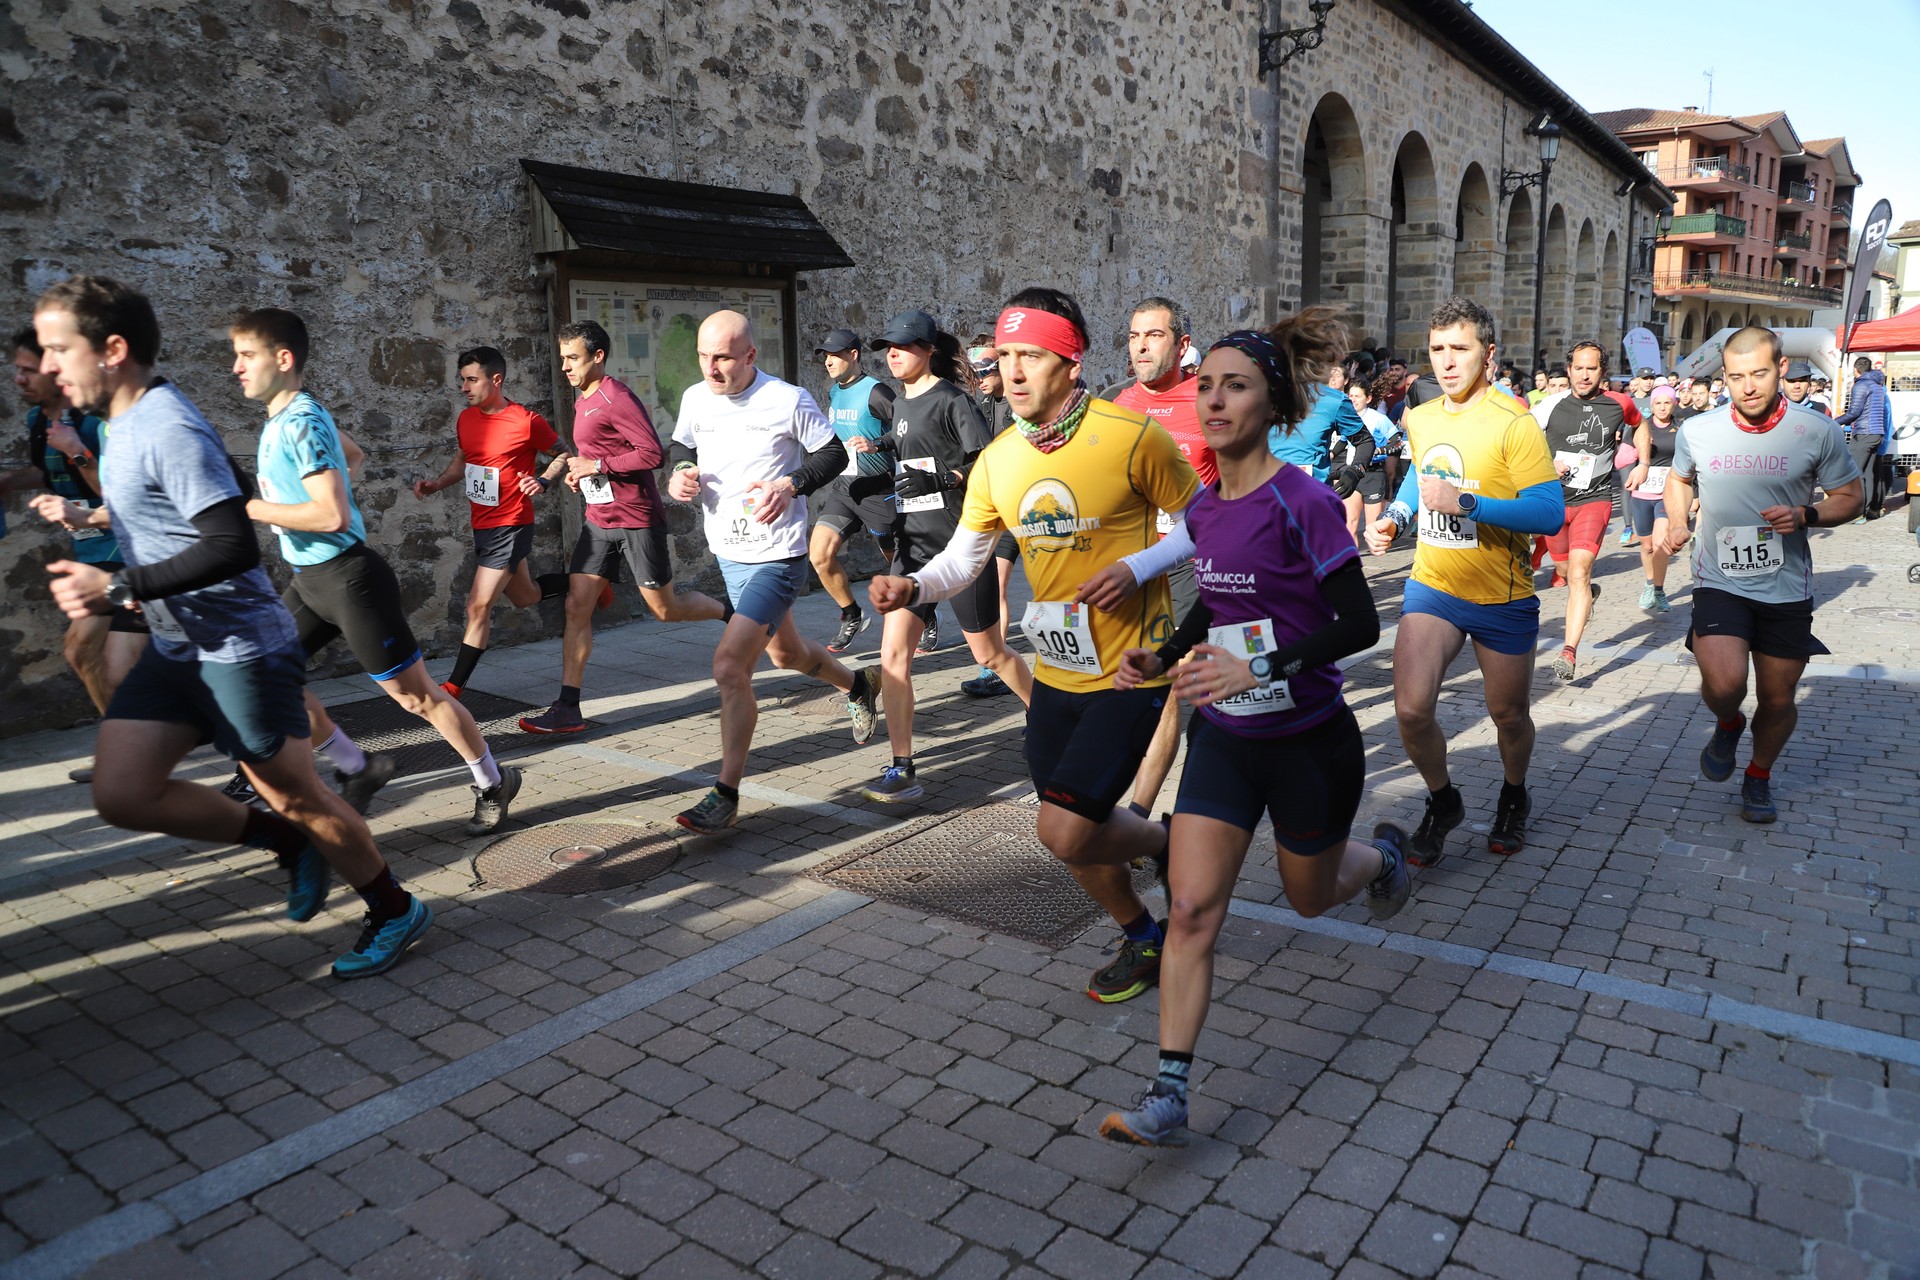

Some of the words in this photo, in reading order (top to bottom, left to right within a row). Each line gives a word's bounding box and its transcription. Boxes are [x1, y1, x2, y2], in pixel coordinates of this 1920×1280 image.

[1724, 454, 1789, 471] BESAIDE
[473, 479, 486, 495] 64
[732, 518, 750, 537] 42
[1428, 510, 1462, 534] 108
[1420, 528, 1474, 541] GEZALUS
[1730, 543, 1769, 563] 115
[1721, 558, 1780, 570] GEZALUS
[1202, 572, 1256, 584] MONACCIA
[1037, 630, 1080, 655] 109
[1039, 648, 1096, 665] GEZALUS
